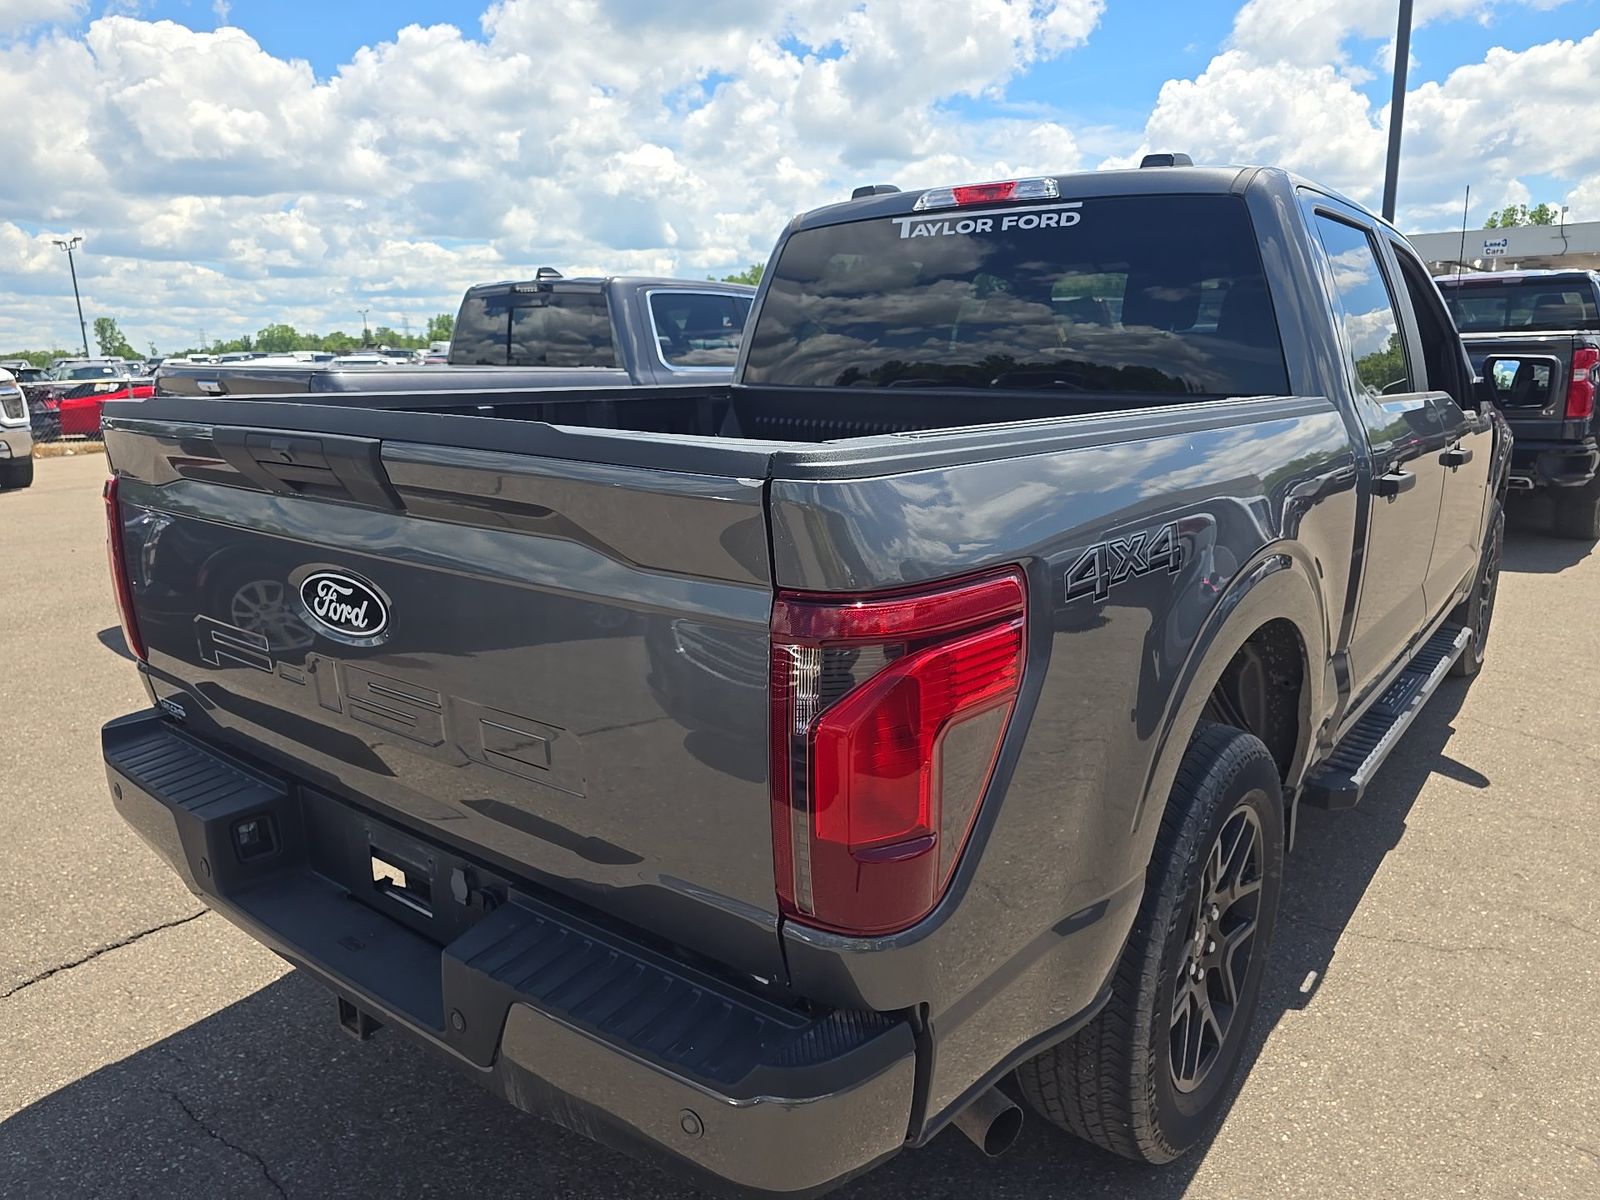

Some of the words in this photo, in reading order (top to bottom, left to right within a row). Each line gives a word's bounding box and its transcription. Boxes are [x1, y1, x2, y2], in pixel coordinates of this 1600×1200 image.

[892, 216, 993, 239] TAYLOR
[1001, 211, 1081, 231] FORD
[313, 580, 368, 628] Ford
[194, 614, 586, 799] F-150
